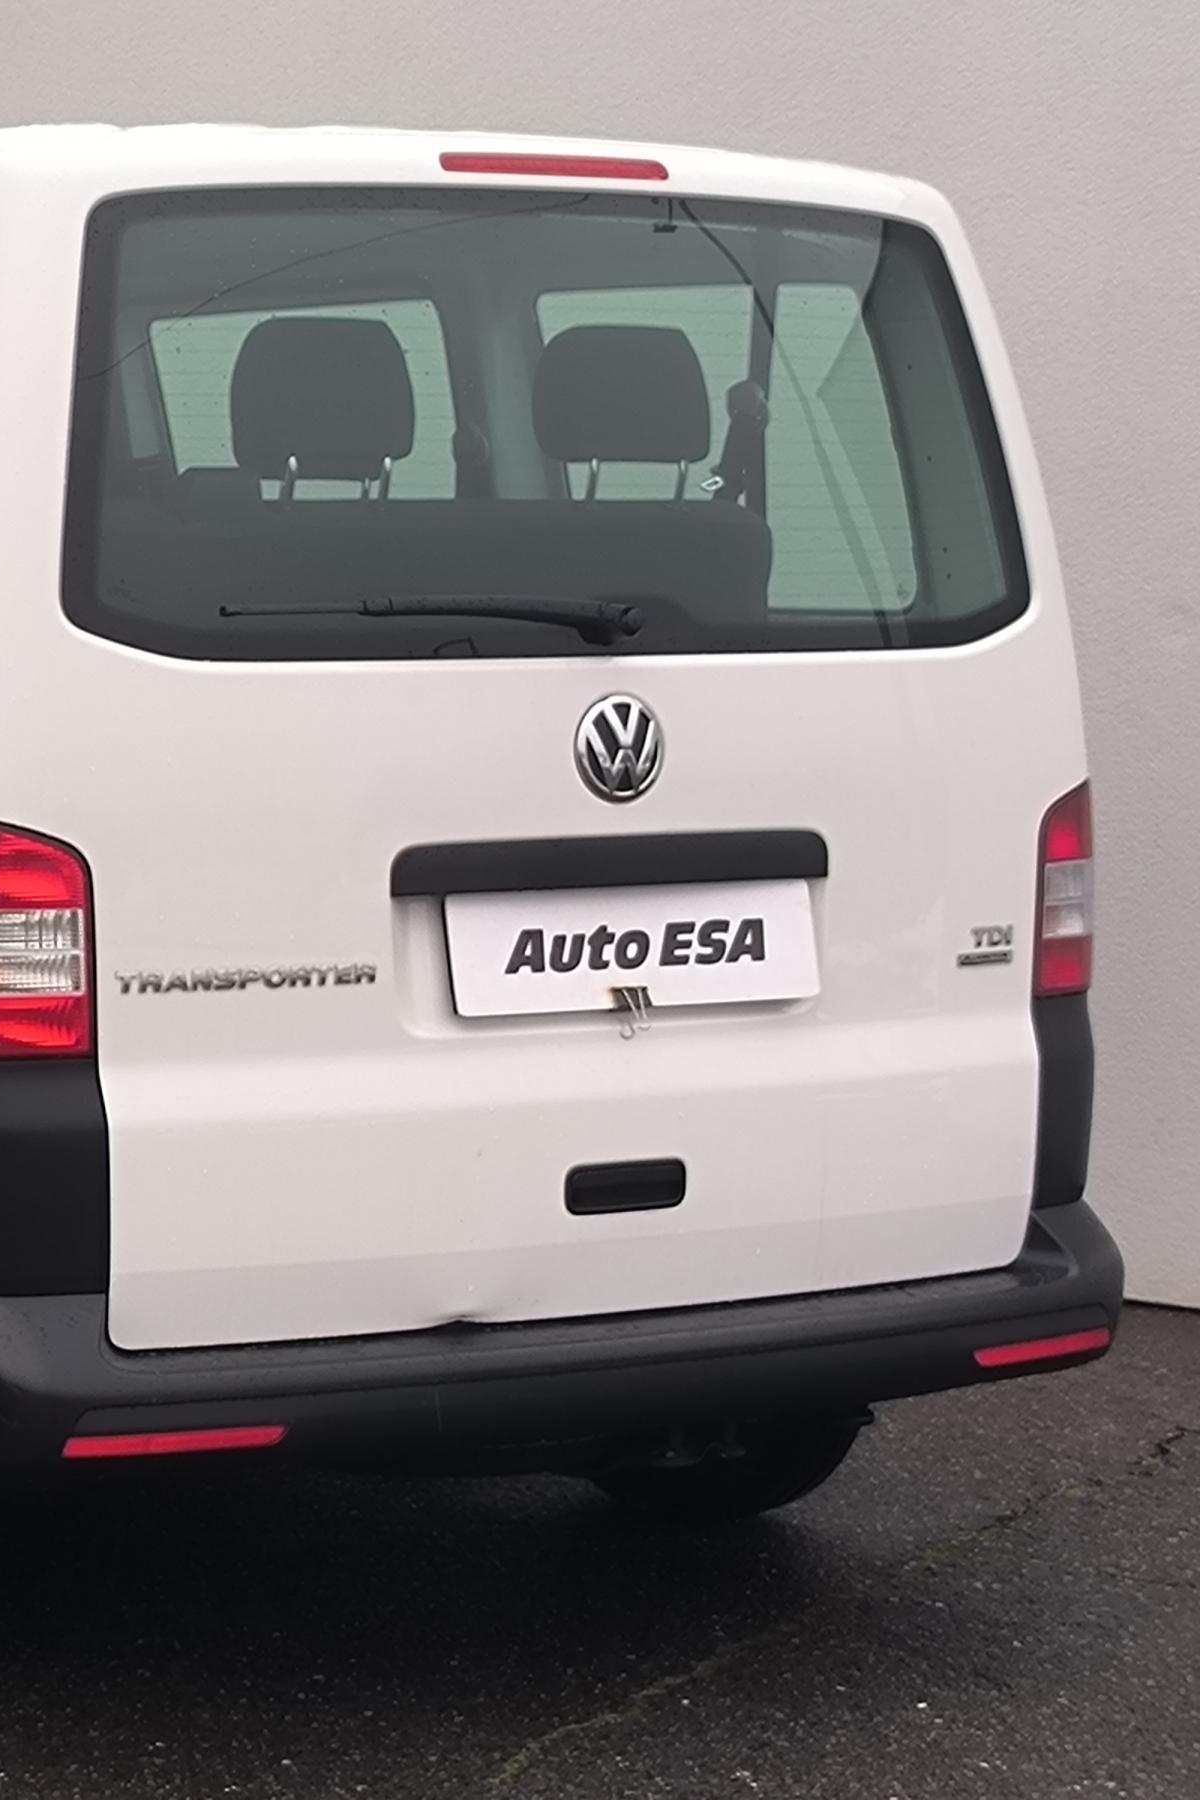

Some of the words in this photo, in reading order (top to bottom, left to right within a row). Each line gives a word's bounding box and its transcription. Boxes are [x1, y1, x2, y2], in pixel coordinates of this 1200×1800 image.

[574, 692, 664, 803] VW
[504, 925, 651, 975] Auto
[658, 917, 767, 967] ESA
[970, 924, 1014, 949] TDI
[114, 963, 377, 995] TRANSPORTER
